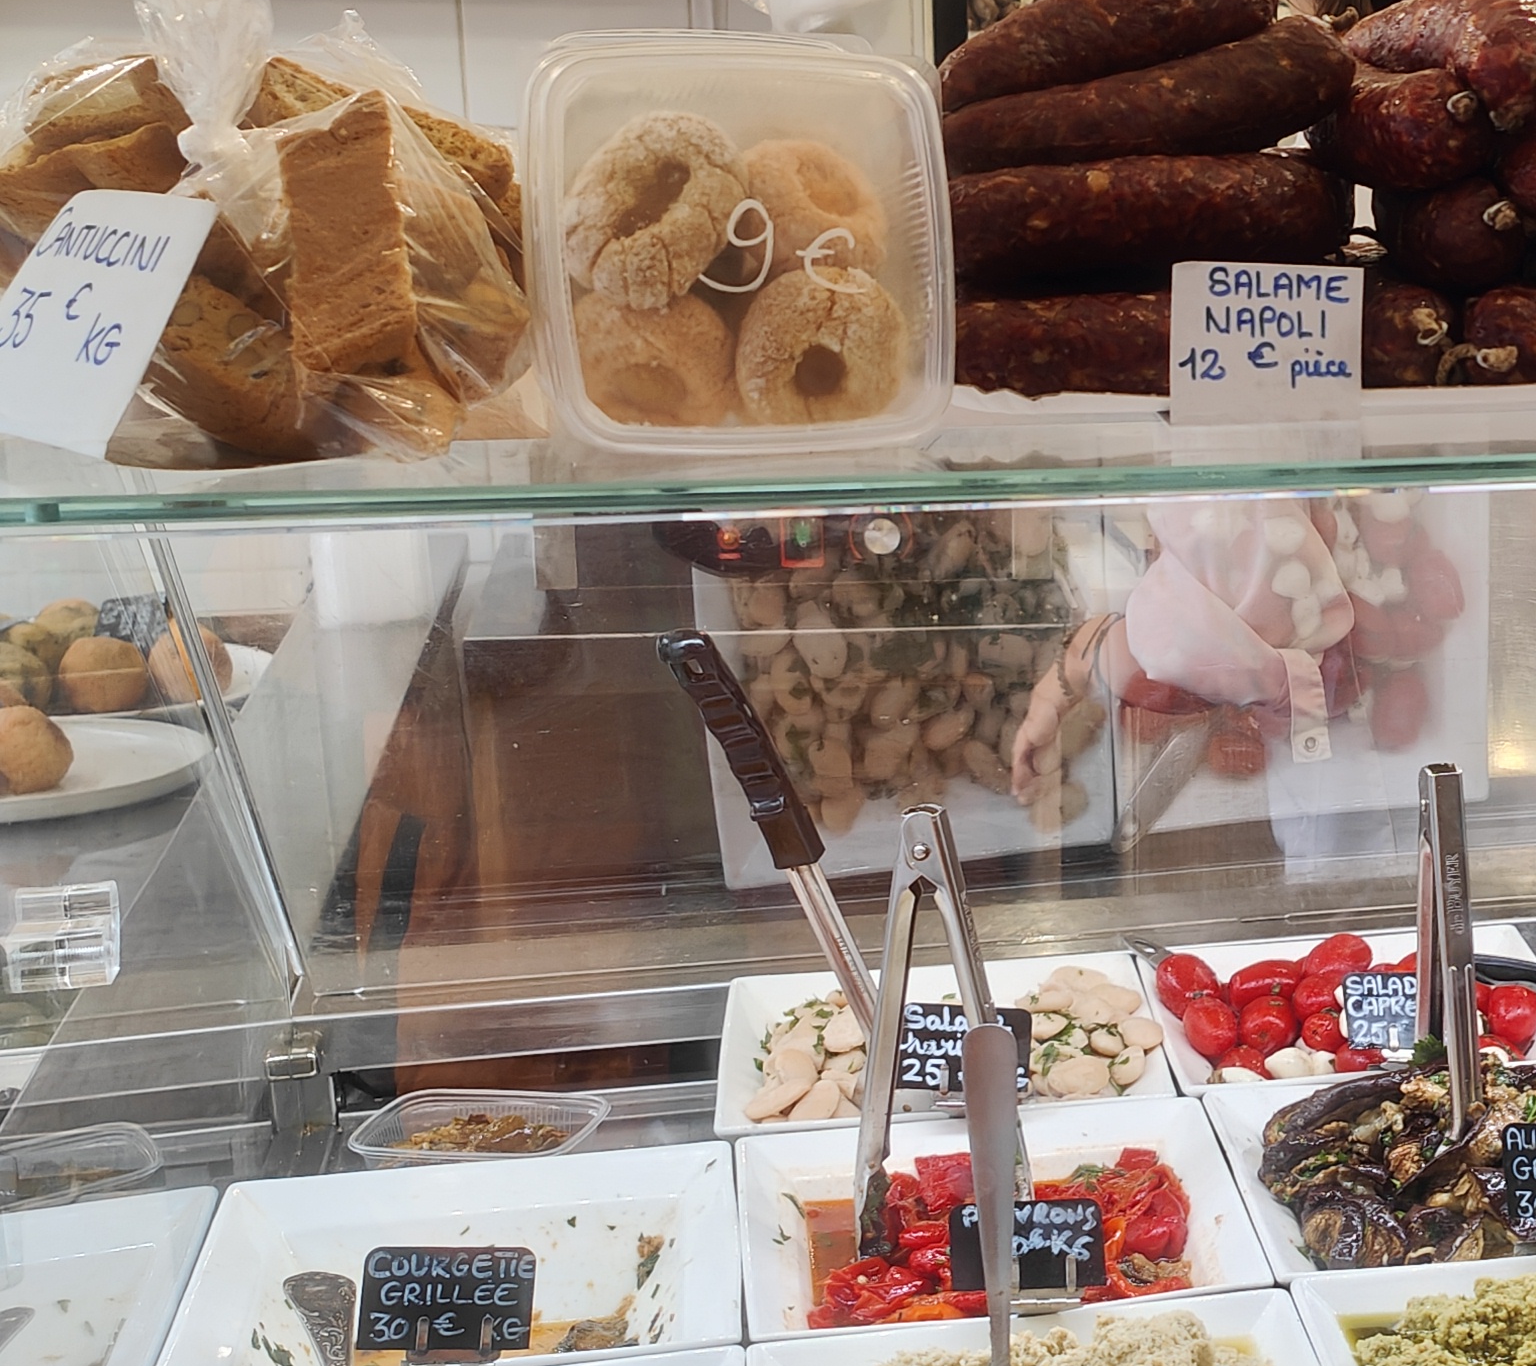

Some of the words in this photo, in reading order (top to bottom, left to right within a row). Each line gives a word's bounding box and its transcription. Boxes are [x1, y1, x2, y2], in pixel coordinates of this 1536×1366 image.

[36, 208, 170, 272] CANTUCCINI
[698, 198, 774, 293] 9
[796, 227, 866, 294] €
[64, 283, 93, 320] €
[1209, 266, 1350, 303] SALAME
[75, 313, 122, 365] KG
[1206, 306, 1327, 338] NAPOLI
[1178, 347, 1226, 380] 12
[1248, 342, 1278, 368] €
[1352, 1020, 1387, 1045] 25
[901, 1058, 948, 1086] 25
[368, 1251, 536, 1278] COURGETTE
[369, 1312, 409, 1342] 30
[432, 1312, 465, 1336] €
